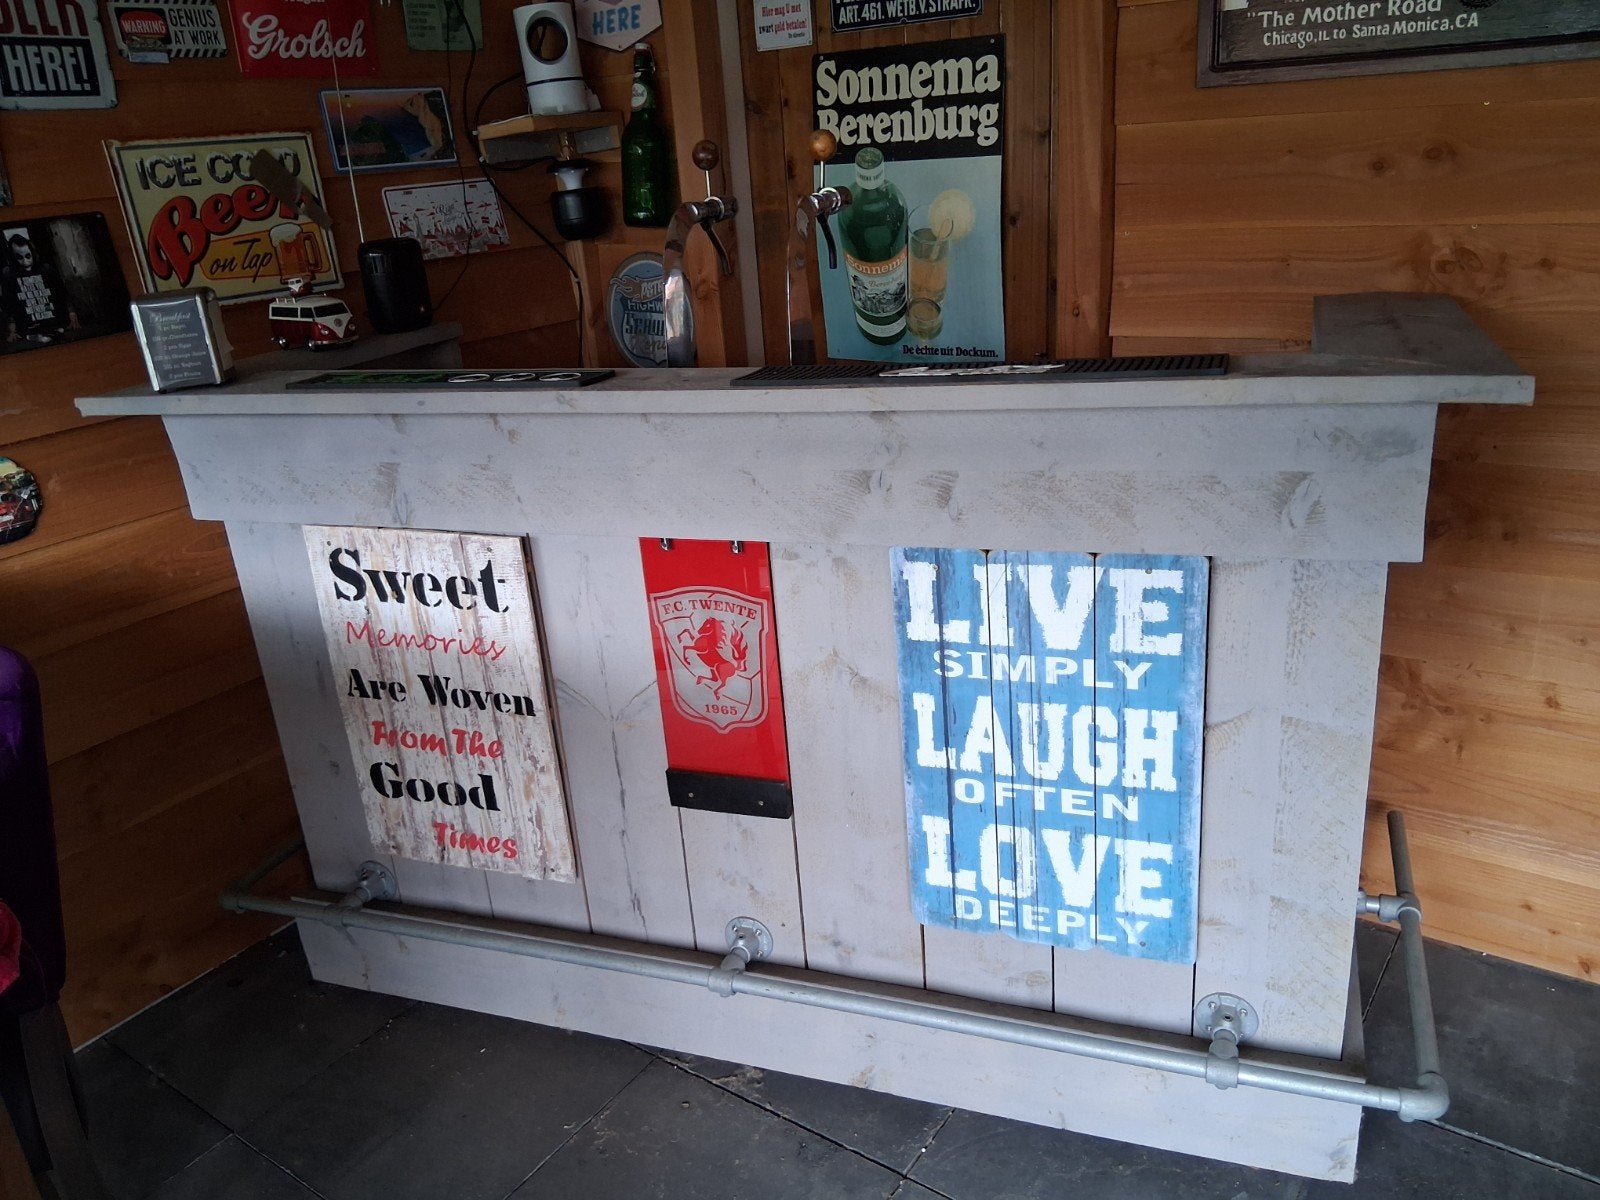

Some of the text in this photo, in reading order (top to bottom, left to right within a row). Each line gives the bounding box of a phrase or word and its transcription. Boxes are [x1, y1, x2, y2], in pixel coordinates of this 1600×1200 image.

[122, 19, 166, 34] WARNING
[168, 8, 216, 27] GENIUS
[592, 4, 641, 35] HERE
[1301, 2, 1382, 25] Mother
[1387, 0, 1442, 16] Road
[1333, 28, 1346, 39] to
[1352, 24, 1390, 38] Santa
[174, 30, 221, 45] AT WORK
[242, 11, 367, 60] Grolsch
[2, 44, 92, 92] HERE!
[816, 54, 1001, 106] Sonnema
[817, 100, 1000, 147] Berenburg
[136, 148, 301, 190] ICE COD
[210, 239, 272, 283] on Tap
[627, 299, 665, 312] HIGHW
[902, 344, 914, 355] De
[940, 346, 954, 356] uit
[955, 346, 998, 358] Dockum.
[329, 547, 510, 614] Sweet
[661, 599, 758, 620] F.C. TWENTE
[902, 561, 1184, 656] LIVE
[346, 621, 506, 661] Memories
[932, 649, 1153, 690] SIMPLY
[347, 668, 536, 717] Are Woven
[704, 703, 738, 717] 1965
[371, 721, 505, 762] From The
[912, 692, 1178, 792] LAUGH
[370, 761, 501, 812] Good
[953, 778, 1139, 822] OFTEN
[432, 822, 518, 859] Times
[921, 815, 1174, 918] LOVE
[956, 896, 1149, 945] DEEPLY
